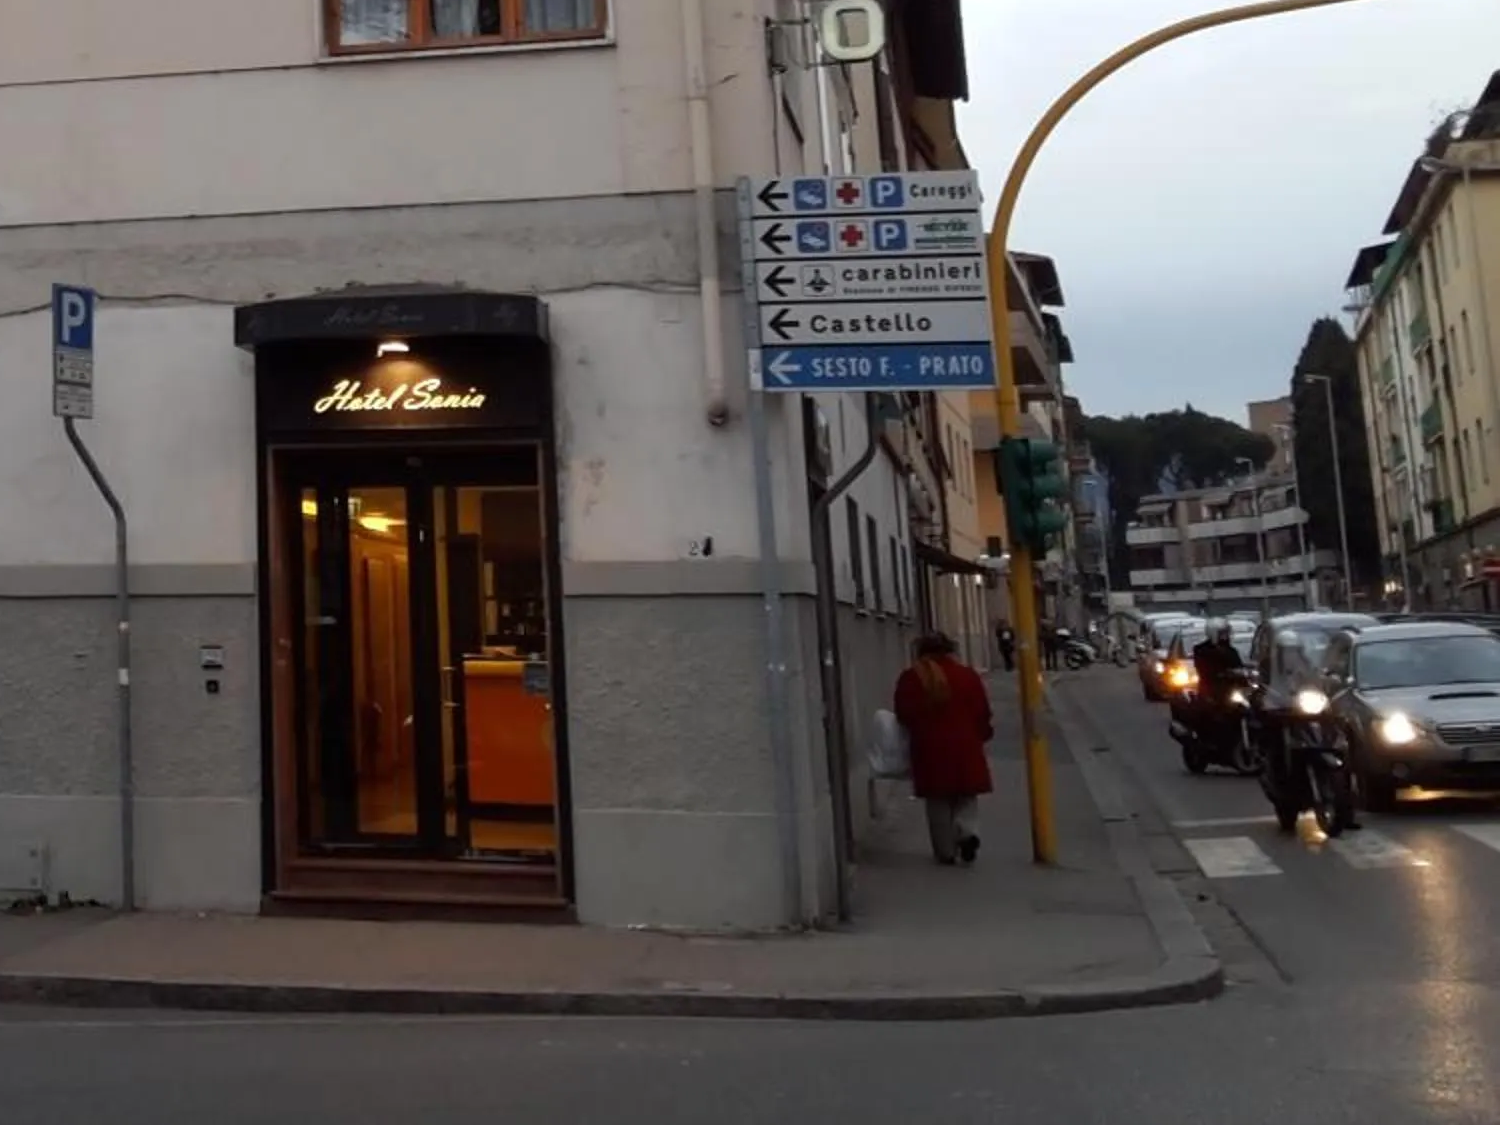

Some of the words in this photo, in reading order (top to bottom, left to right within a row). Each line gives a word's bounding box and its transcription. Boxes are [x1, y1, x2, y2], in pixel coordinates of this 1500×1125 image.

[876, 180, 896, 204] P
[909, 182, 973, 200] Careggi
[880, 223, 900, 247] P
[841, 261, 981, 282] carabinieri
[61, 291, 86, 343] P
[809, 314, 933, 334] Castello
[811, 357, 873, 378] SESTO
[879, 357, 896, 376] F.
[918, 355, 984, 376] PRATO
[313, 379, 406, 413] Hotel
[403, 377, 487, 411] Sonia
